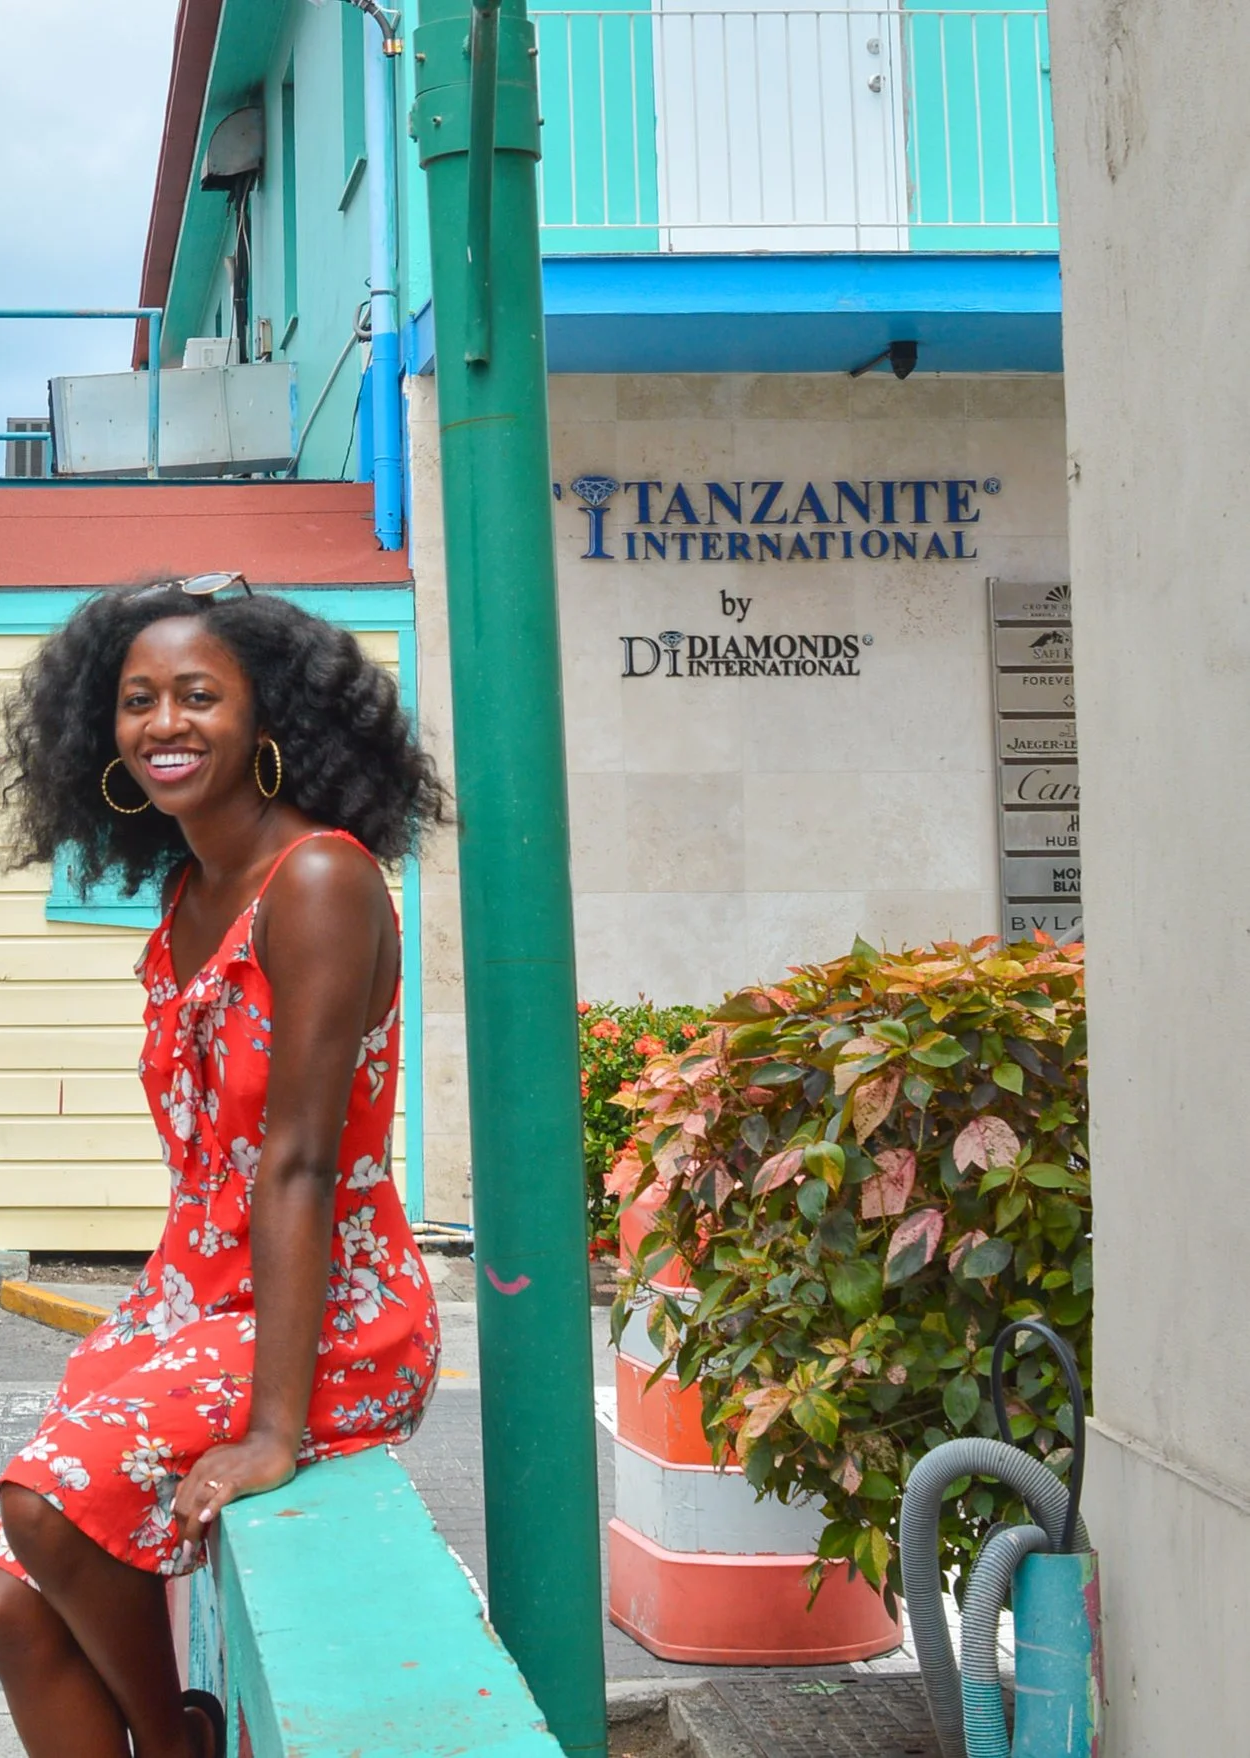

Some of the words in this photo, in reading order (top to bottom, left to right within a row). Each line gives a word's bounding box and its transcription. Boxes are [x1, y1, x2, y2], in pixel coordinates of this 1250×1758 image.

[622, 529, 978, 561] INTERNATIONAL
[719, 590, 752, 622] by
[1022, 603, 1058, 611] CROWN
[1061, 603, 1071, 611] O
[687, 659, 861, 677] INTERNATIONAL
[1022, 676, 1074, 686] FOREVE
[1045, 836, 1078, 847] HUB
